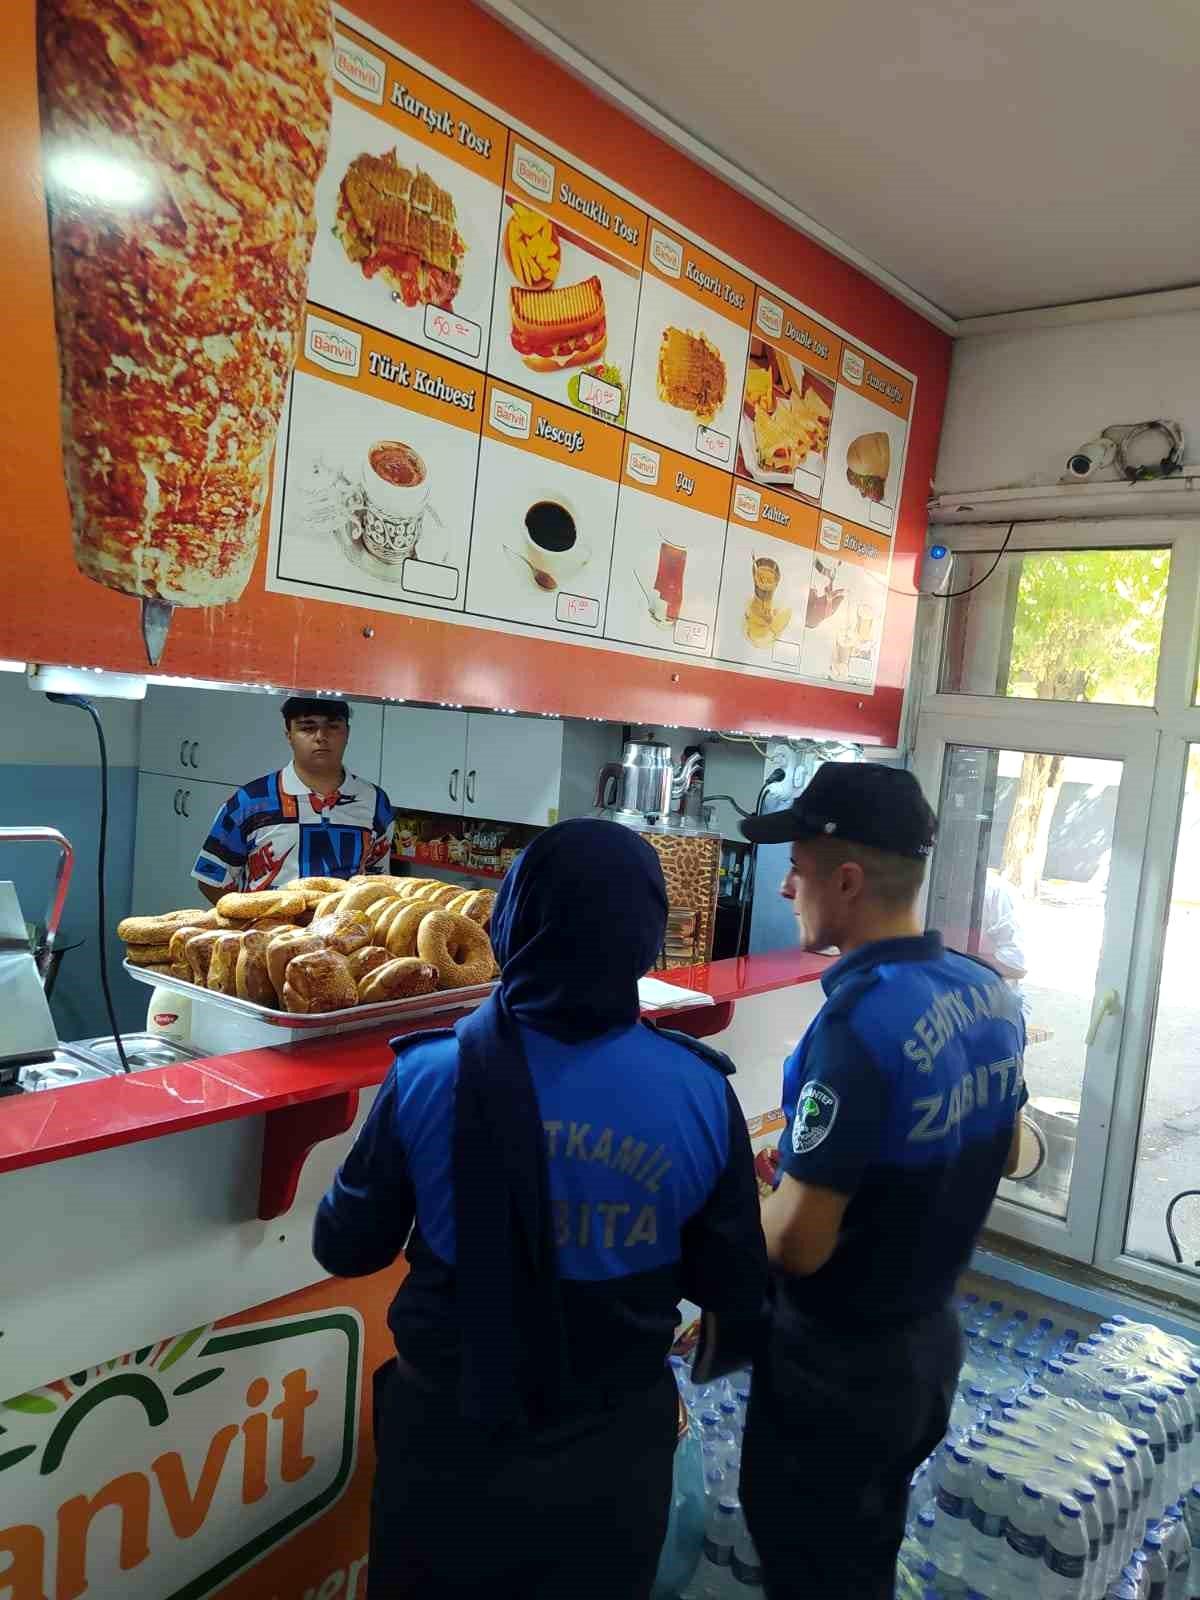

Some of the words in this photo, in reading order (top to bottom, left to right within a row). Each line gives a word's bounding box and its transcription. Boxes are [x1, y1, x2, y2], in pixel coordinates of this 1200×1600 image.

[391, 81, 455, 137] Karışık
[457, 121, 492, 159] Tost
[560, 183, 611, 229] Sucuklu
[612, 216, 639, 246] Tost
[723, 283, 745, 311] Tost
[313, 333, 353, 362] Banvit
[368, 351, 410, 386] Türk
[412, 368, 476, 412] Kahvesi
[496, 406, 526, 427] Banvit
[535, 415, 585, 453] Nescafe
[675, 471, 695, 495] Çay
